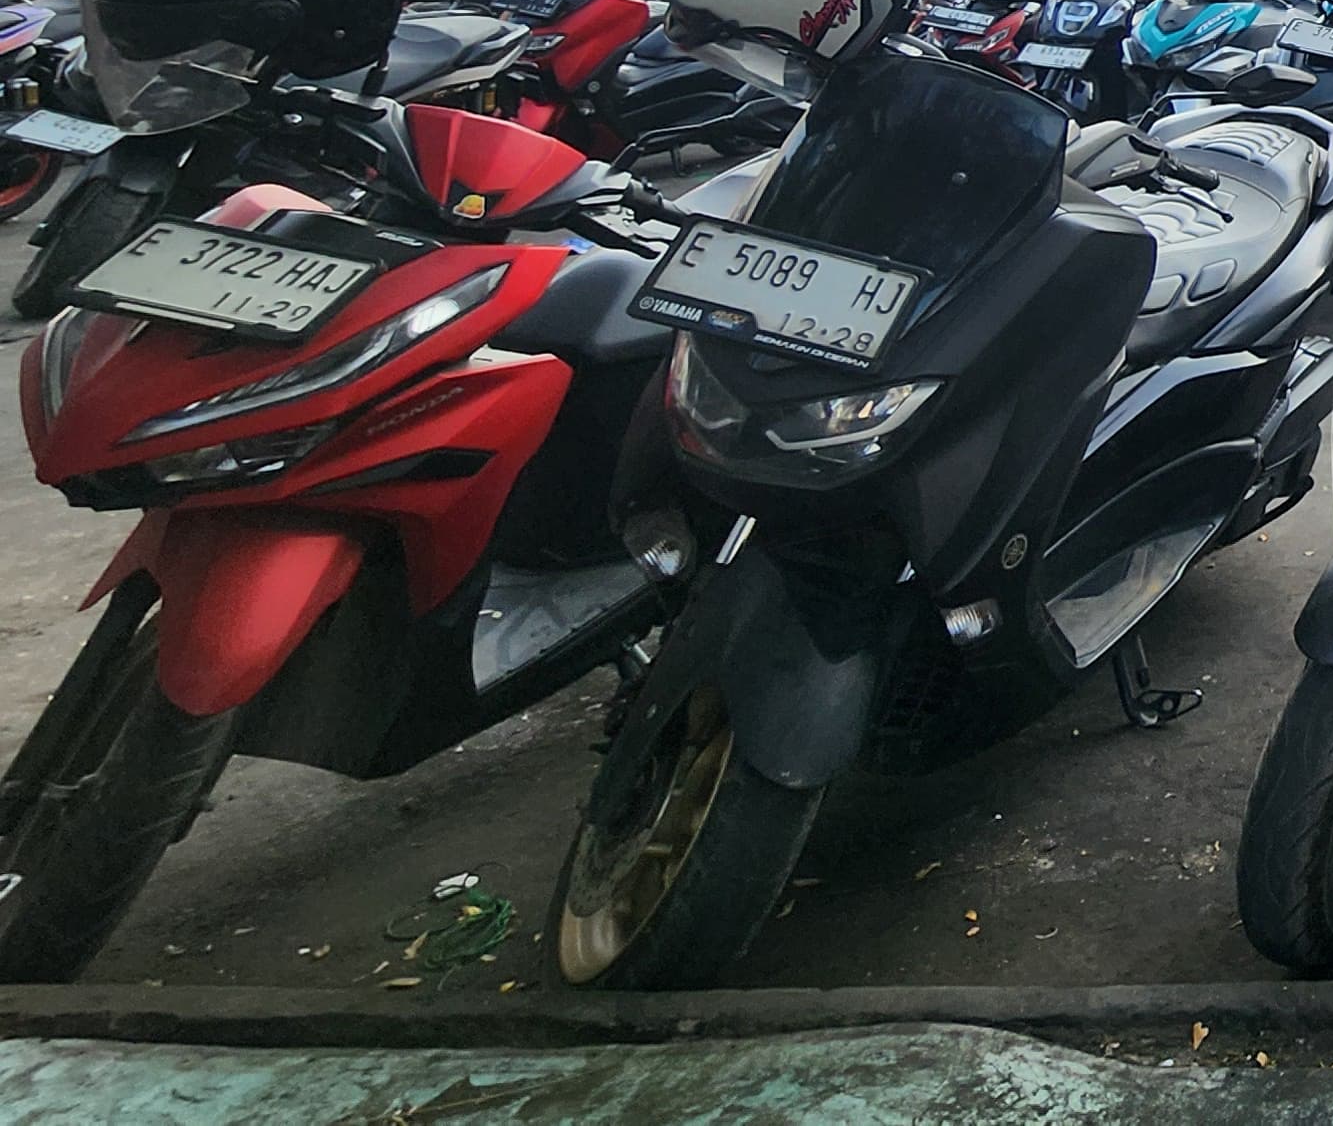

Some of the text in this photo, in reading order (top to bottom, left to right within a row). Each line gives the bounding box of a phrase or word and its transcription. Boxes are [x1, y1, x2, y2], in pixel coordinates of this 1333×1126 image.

[1291, 21, 1300, 32] E
[128, 227, 364, 295] E 3722 HAJ
[680, 232, 906, 315] E 5089 HJ
[652, 299, 703, 323] YAMAHA
[753, 333, 810, 355] SEMAKIN
[823, 350, 870, 369] DEPAN
